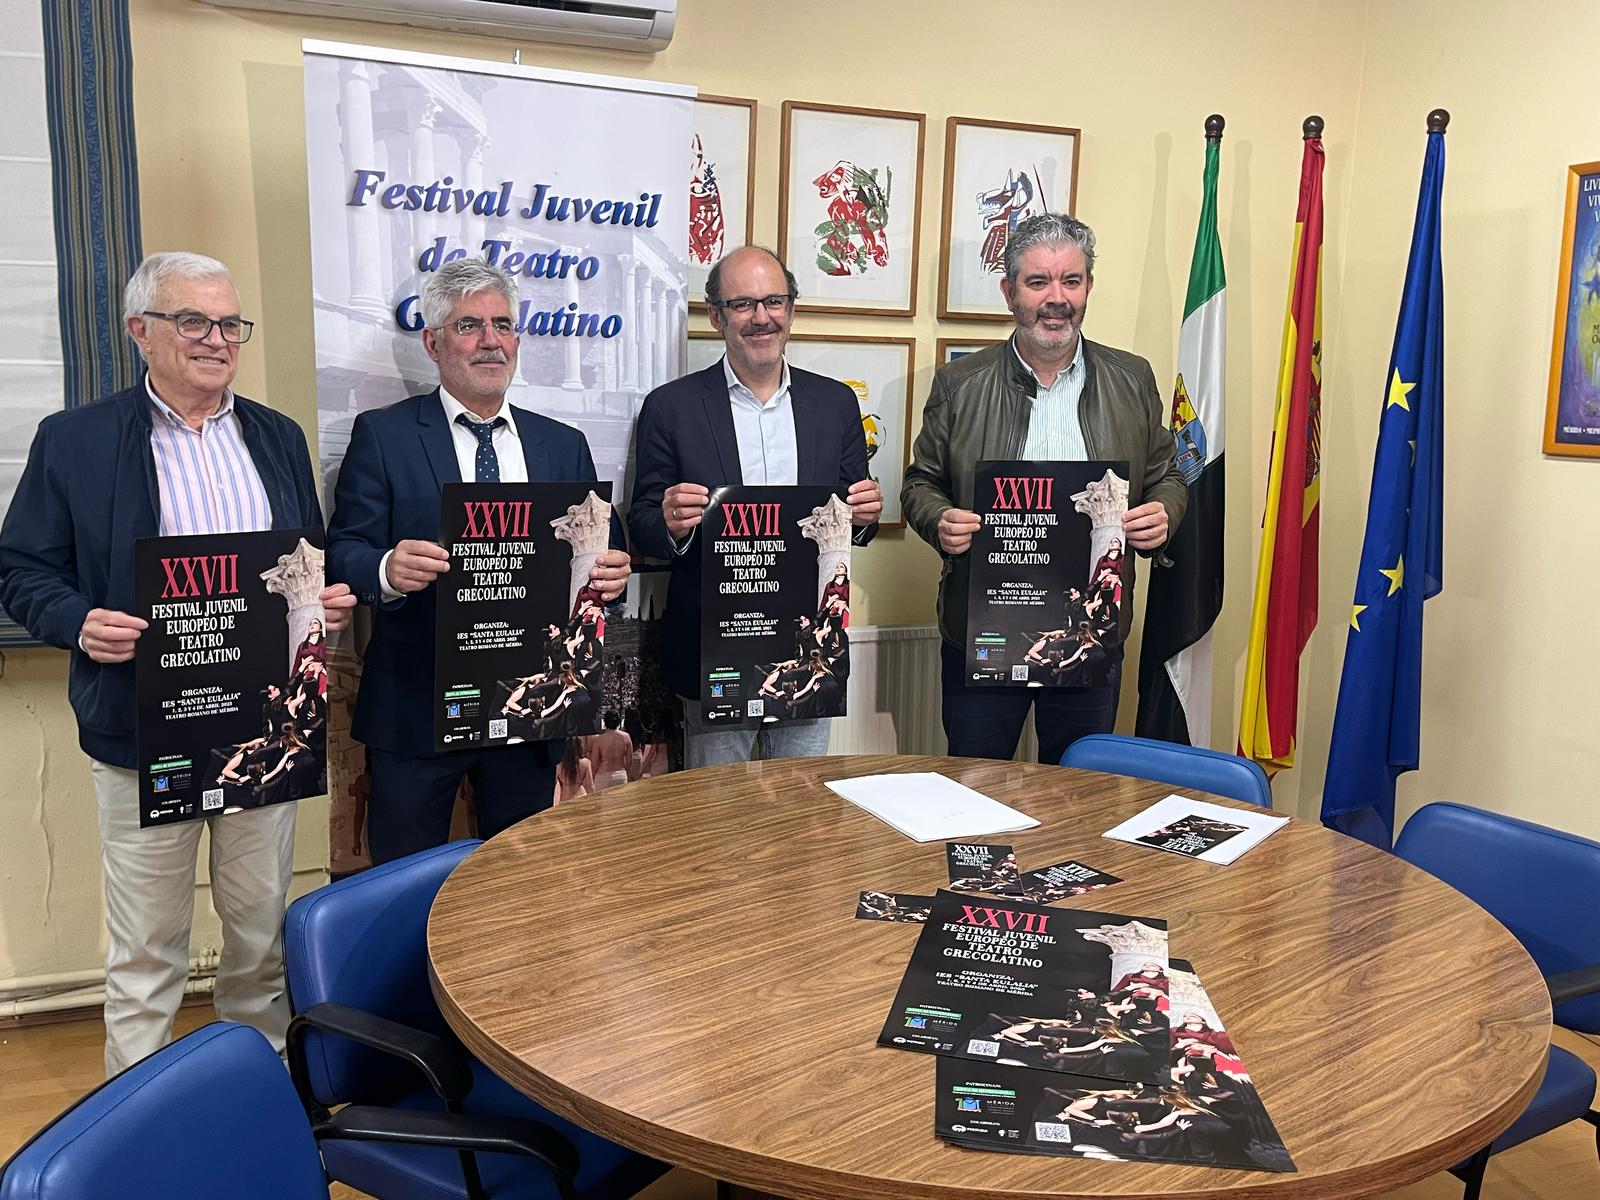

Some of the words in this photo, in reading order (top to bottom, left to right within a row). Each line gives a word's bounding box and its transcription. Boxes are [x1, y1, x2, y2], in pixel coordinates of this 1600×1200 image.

[346, 170, 514, 217] Festival
[520, 184, 662, 228] Juvenil
[482, 240, 600, 281] Teatro
[396, 296, 622, 338] Glatino
[992, 478, 1054, 510] XXVII
[462, 502, 532, 538] XXVII
[721, 504, 780, 536] XXVII
[985, 514, 1022, 525] FESTIVAL
[1023, 514, 1058, 526] JUVENIL
[994, 527, 1033, 538] EUROPEO
[1035, 527, 1047, 538] DE
[452, 543, 496, 556] FESTIVAL
[497, 542, 536, 556] JUVENIL
[714, 541, 751, 553] FESTIVAL
[752, 540, 786, 553] JUVENIL
[1003, 540, 1037, 551] TEATRO
[463, 558, 507, 571] EUROPEO
[510, 557, 523, 569] DE
[724, 555, 762, 566] EUROPEO
[764, 554, 775, 566] DE
[988, 553, 1050, 564] GRECOLATINO
[160, 554, 239, 598] XXVII
[473, 572, 512, 585] TEATRO
[733, 568, 766, 580] TEATRO
[457, 586, 526, 602] GRECOLATINO
[720, 581, 780, 594] GRECOLATINO
[152, 601, 202, 619] FESTIVAL
[205, 598, 247, 617] JUVENIL
[166, 618, 217, 634] EUROPEO
[220, 616, 235, 629] DE
[474, 622, 509, 630] ORGANIZA:
[179, 632, 224, 650] TEATRO
[160, 647, 240, 668] GRECOLATINO
[182, 686, 223, 697] ORGANIZA:
[162, 700, 175, 708] IES
[177, 697, 206, 706] "SANTA
[208, 692, 241, 703] EULALIA"
[954, 844, 989, 854] XXVII
[956, 905, 1050, 934] XXVII
[942, 923, 1000, 937] FESTIVAL
[1002, 930, 1057, 944] JUVENIL
[956, 932, 1016, 947] EUROPEO
[1020, 940, 1039, 950] DE
[968, 942, 1022, 956] TEATRO
[943, 948, 1043, 968] GRECOLATINO
[962, 970, 1014, 980] ORGANIZA:
